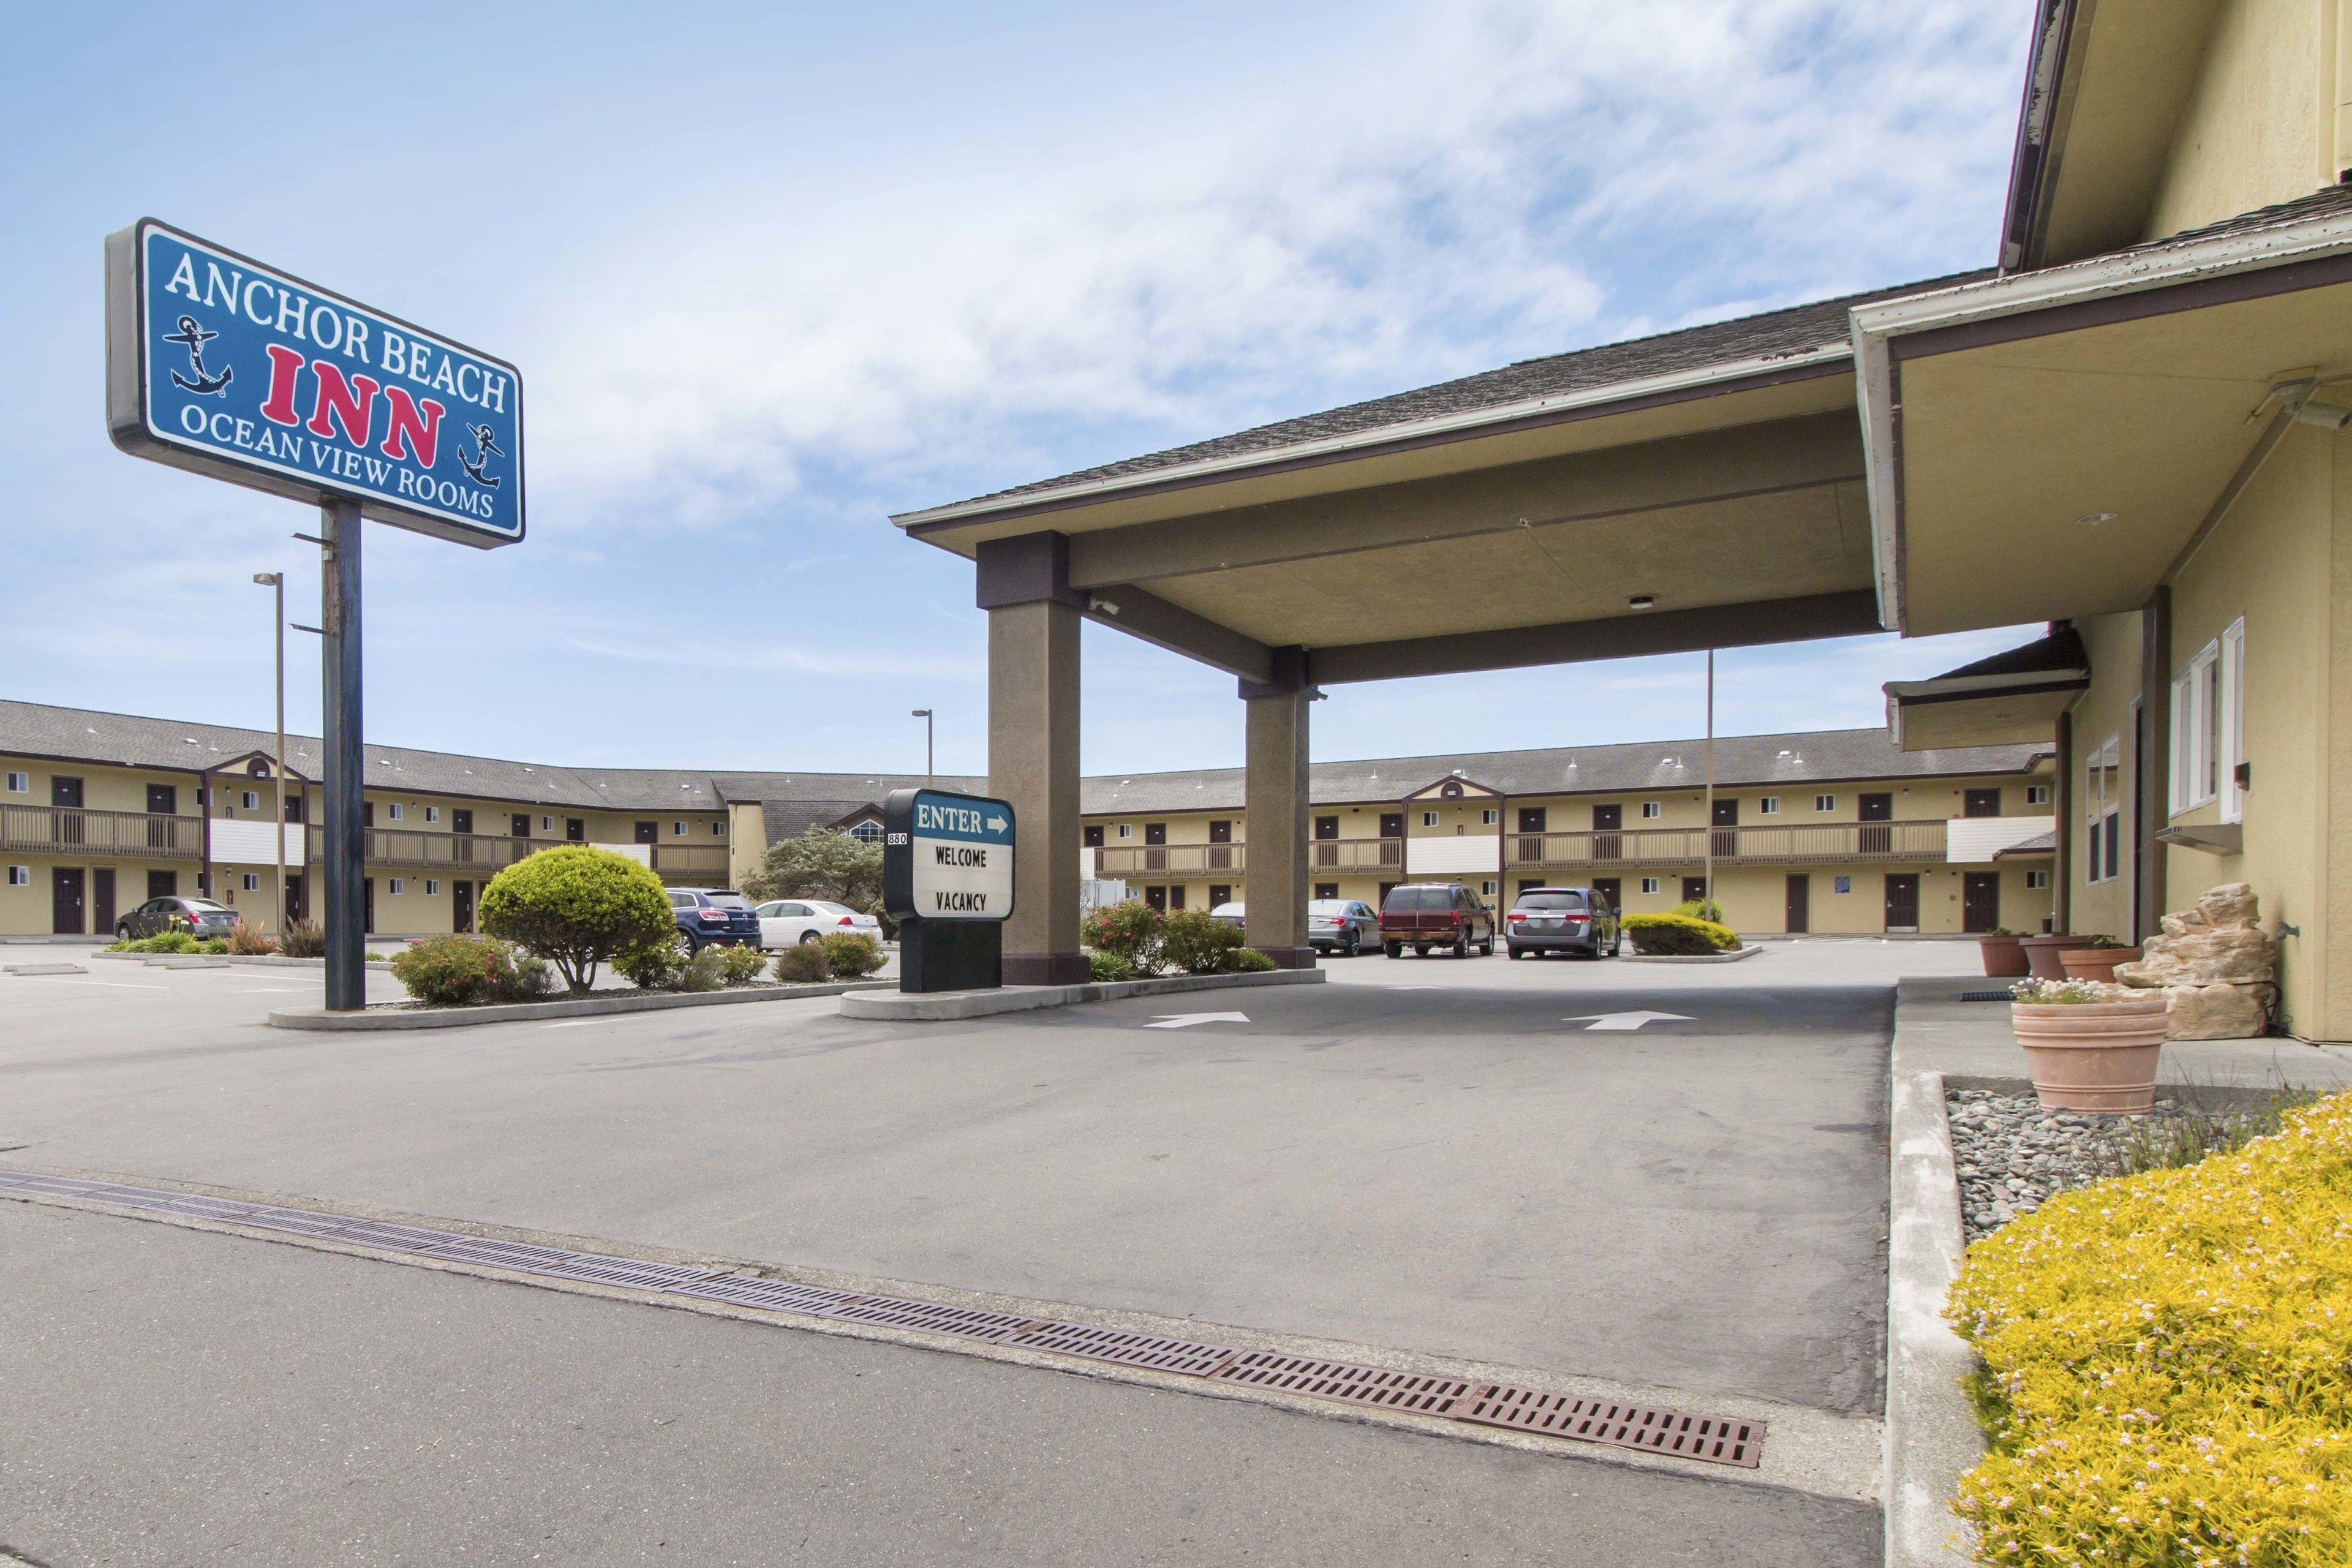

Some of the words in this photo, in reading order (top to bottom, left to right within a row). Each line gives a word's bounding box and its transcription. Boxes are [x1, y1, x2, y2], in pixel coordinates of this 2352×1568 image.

[165, 252, 371, 364] ANCHOR
[380, 330, 507, 413] BEACH
[260, 343, 446, 469] INN
[181, 404, 303, 463] OCEAN
[310, 443, 393, 487] VIEW
[398, 467, 493, 518] ROOMS
[918, 804, 982, 834] ENTER
[889, 835, 907, 844] 880
[936, 846, 986, 867] WELCOME
[937, 892, 987, 911] VACANCY
